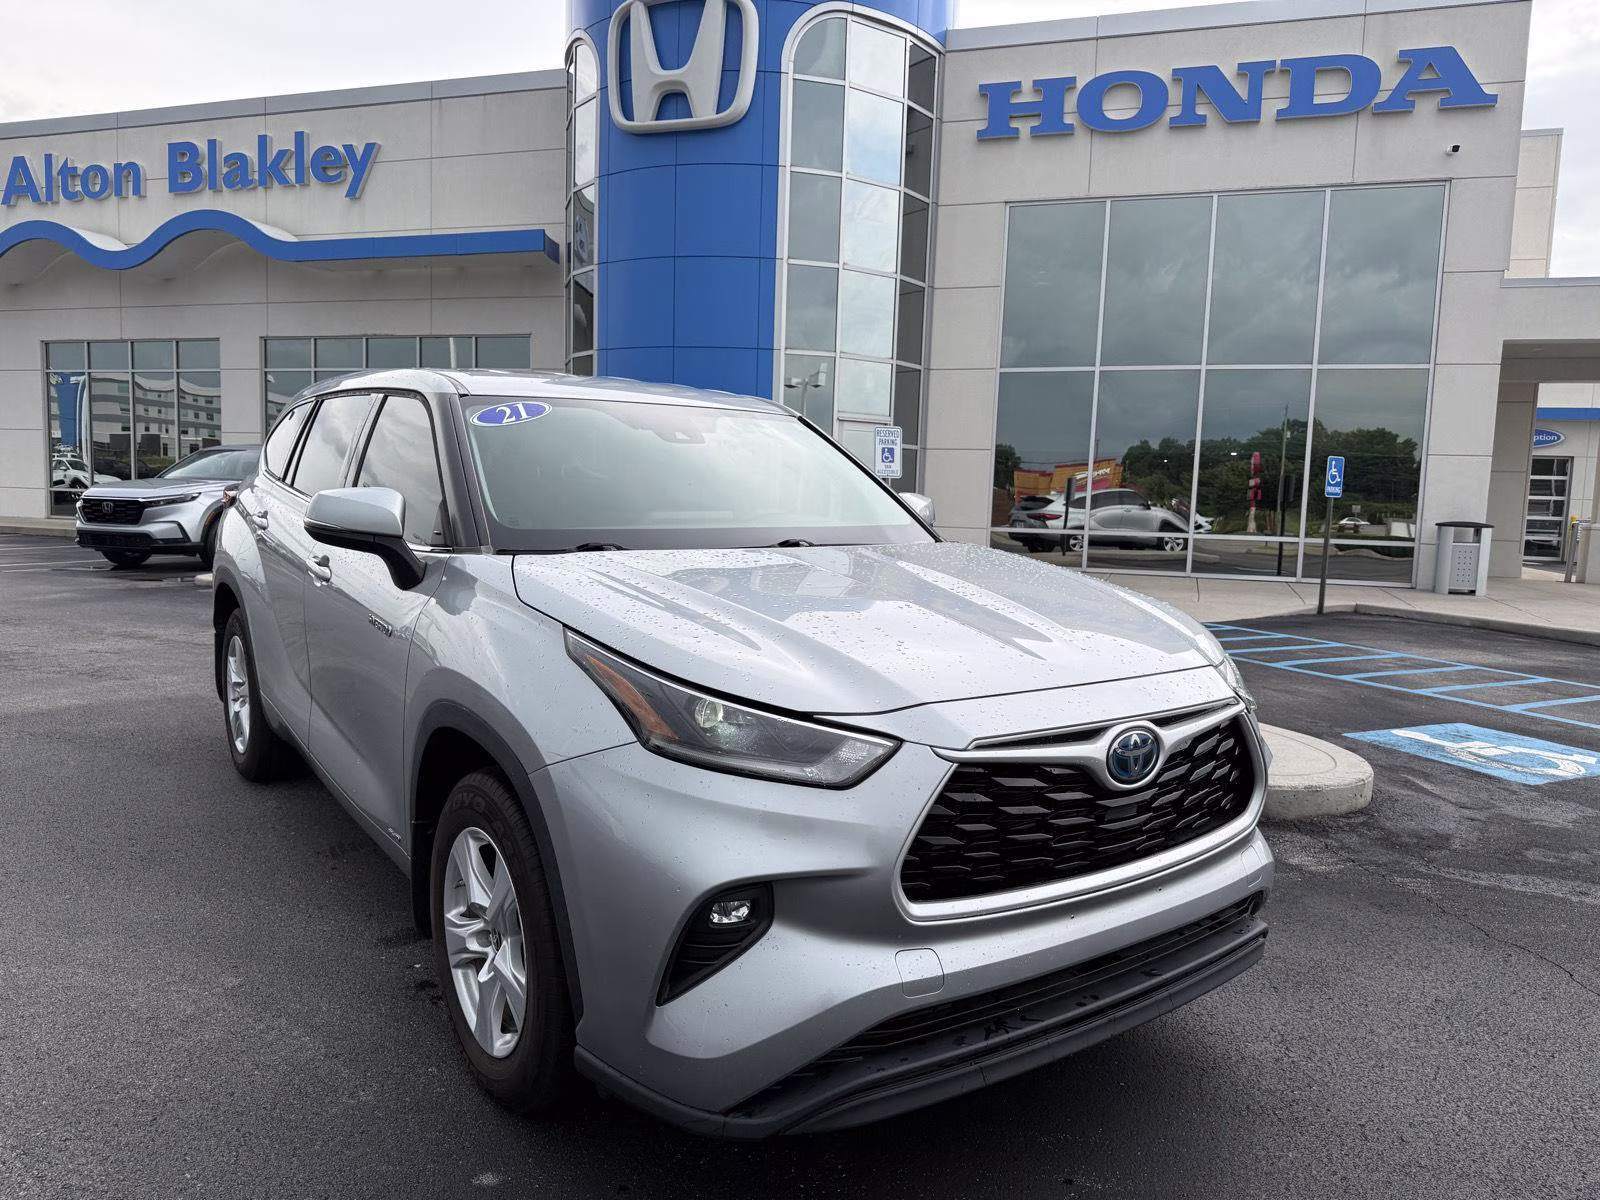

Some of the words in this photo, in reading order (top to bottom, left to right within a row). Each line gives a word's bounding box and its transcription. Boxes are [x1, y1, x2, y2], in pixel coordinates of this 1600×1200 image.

[977, 46, 1498, 139] HONDA
[2, 153, 146, 207] Alton
[167, 130, 381, 200] Blakley
[495, 402, 532, 424] 21
[876, 429, 900, 439] RESERVED
[878, 438, 898, 446] PARKING
